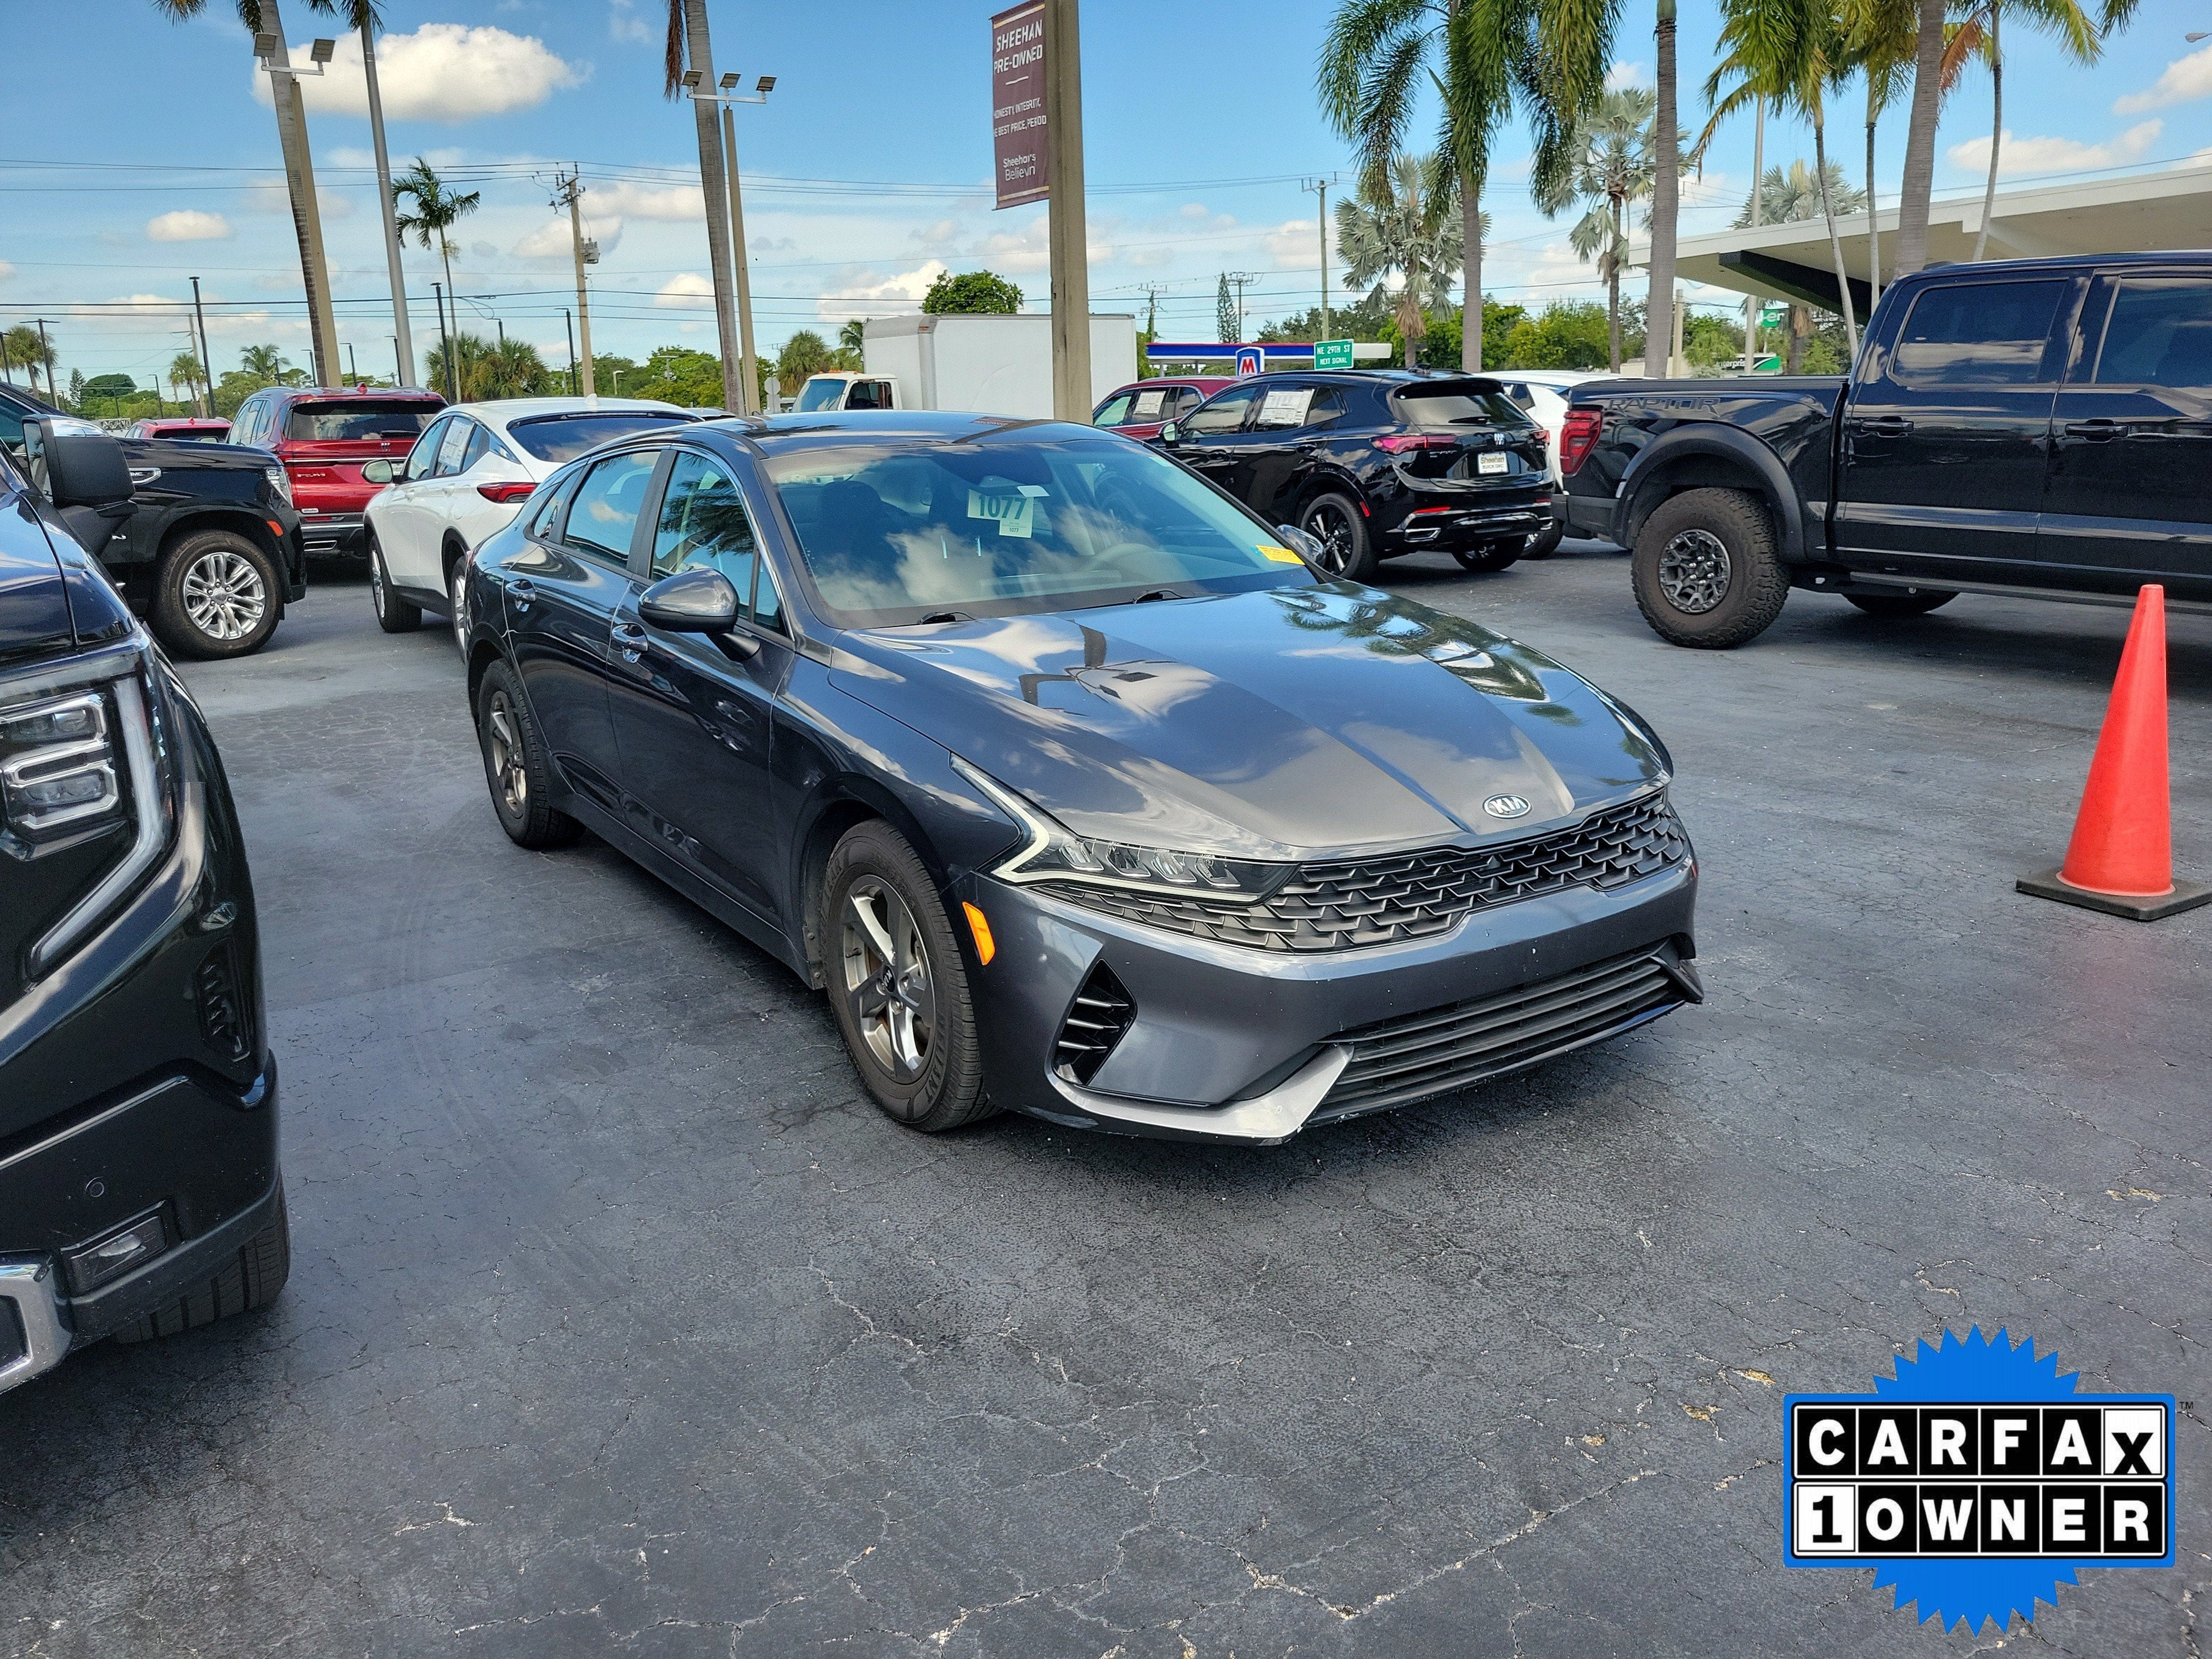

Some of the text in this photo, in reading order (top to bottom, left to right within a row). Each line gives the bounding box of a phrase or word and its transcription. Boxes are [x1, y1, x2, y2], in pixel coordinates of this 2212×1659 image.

[996, 19, 1042, 53] SHEEHAN
[994, 44, 1043, 75] PRE-OWNED
[1317, 344, 1351, 355] NE 29TH ST
[1608, 398, 1720, 418] RAPTOR
[979, 494, 1027, 520] 1077
